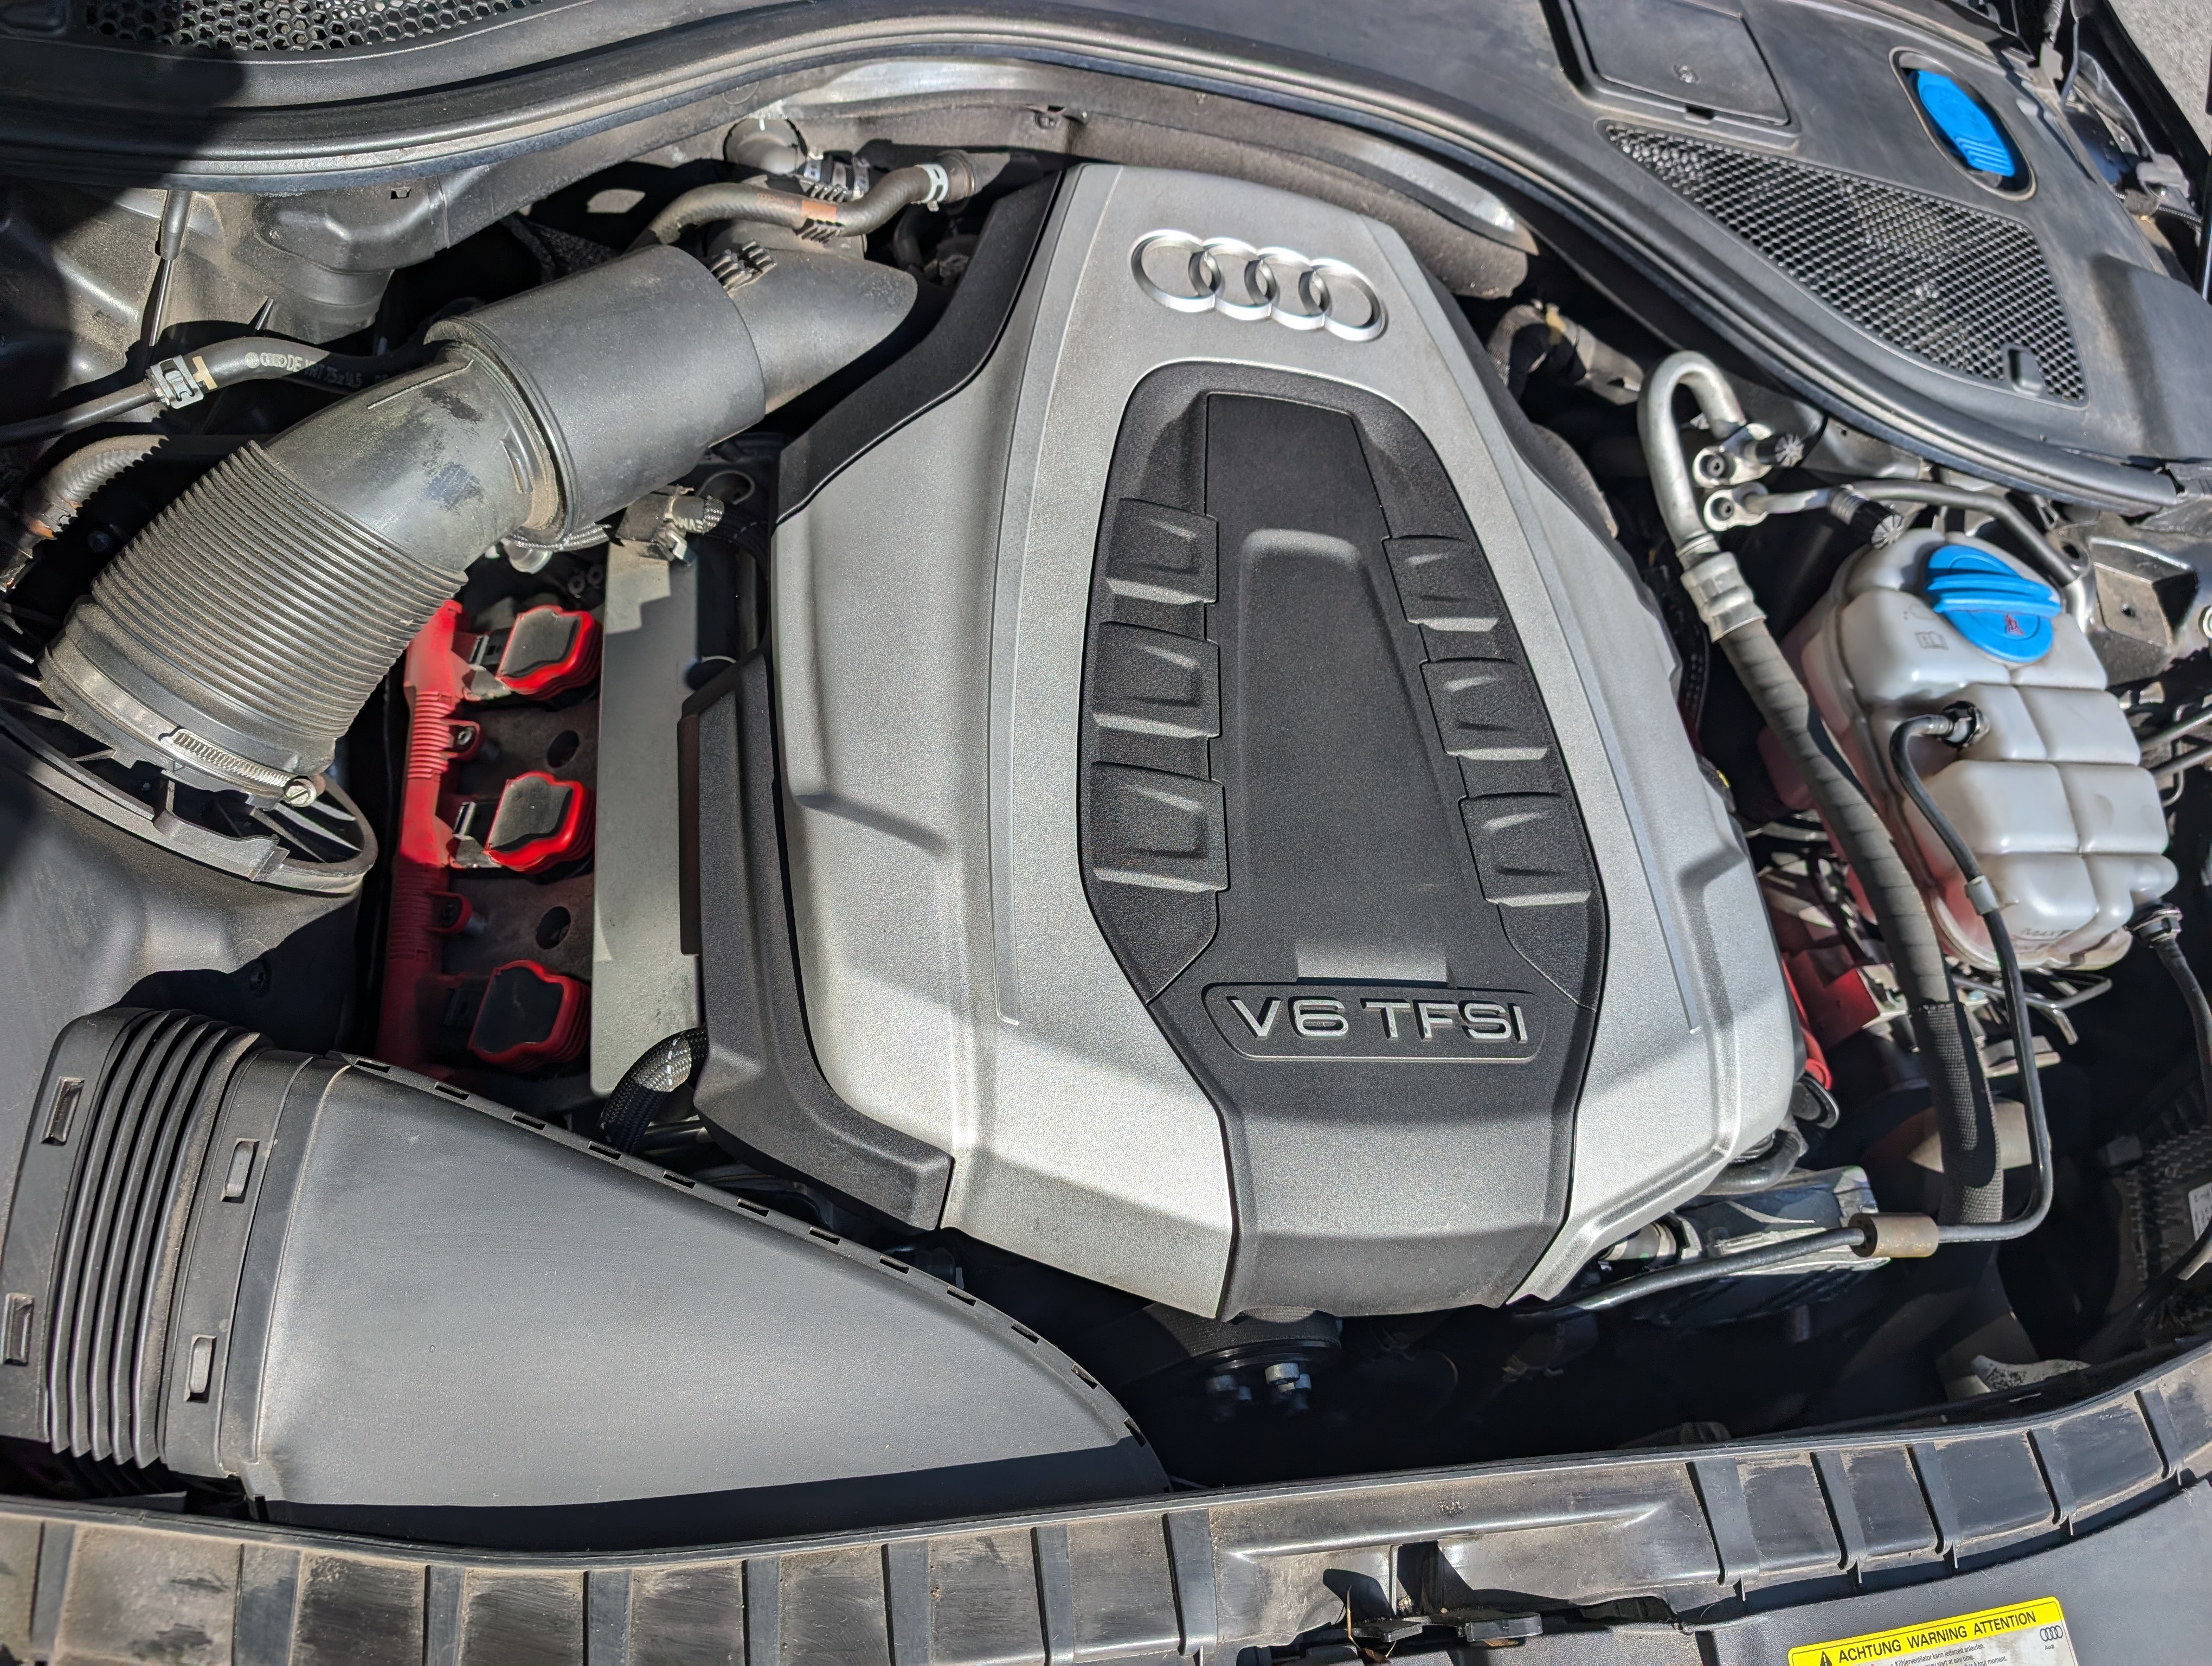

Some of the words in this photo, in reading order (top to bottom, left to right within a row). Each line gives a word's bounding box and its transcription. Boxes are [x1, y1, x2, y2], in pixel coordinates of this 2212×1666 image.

[1229, 999, 1349, 1039] V6
[1364, 1001, 1528, 1045] TFSI
[1839, 1639, 1901, 1663] ACHTUNG
[1906, 1626, 1967, 1649] WARNING
[1974, 1611, 2036, 1635] ATTENTION
[1895, 1655, 1932, 1666] Kühlerventilator
[1944, 1648, 1964, 1658] jederzeit
[1964, 1643, 1985, 1653] anlaufen.
[1988, 1656, 2008, 1665] moment.
